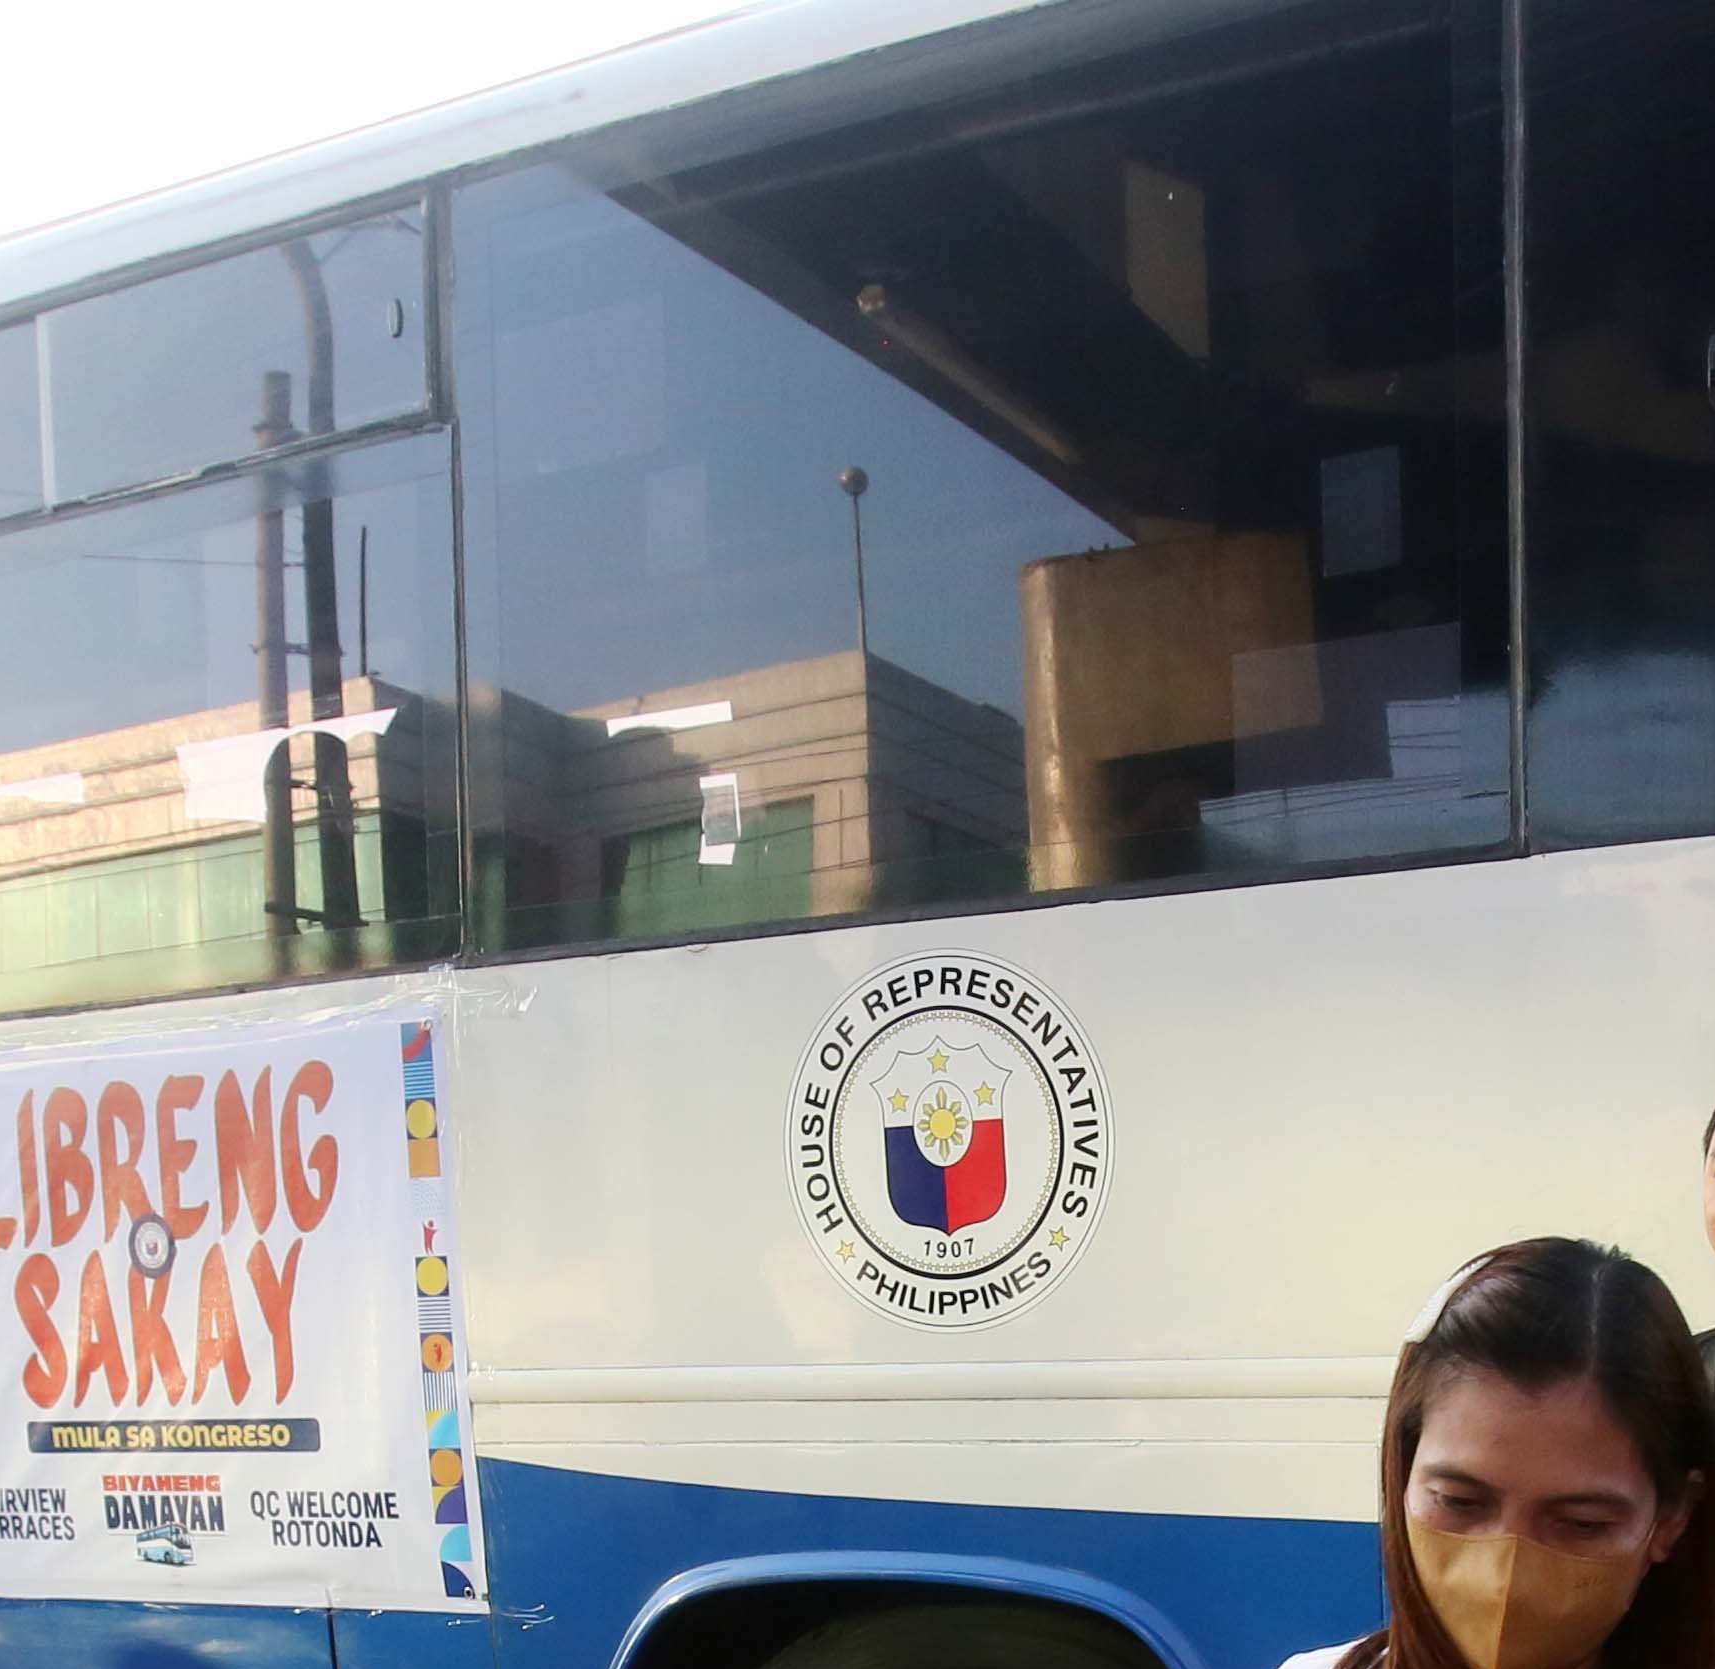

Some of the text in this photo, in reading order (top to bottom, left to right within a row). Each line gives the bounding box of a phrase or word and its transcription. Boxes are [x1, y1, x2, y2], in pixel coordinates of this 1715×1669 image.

[800, 967, 1100, 1234] HOUSE OF REPRESENTATIVES
[923, 1238, 975, 1259] 1907
[856, 1251, 1052, 1315] PHILIPPINES
[14, 1237, 303, 1408] SAKAY
[51, 1422, 291, 1449] MULA SA KONGRESO
[102, 1474, 221, 1492] BIYAHENG
[105, 1494, 227, 1532] DAMAYAN
[250, 1490, 400, 1520] QC WELCOME
[271, 1519, 383, 1549] ROTONDA
